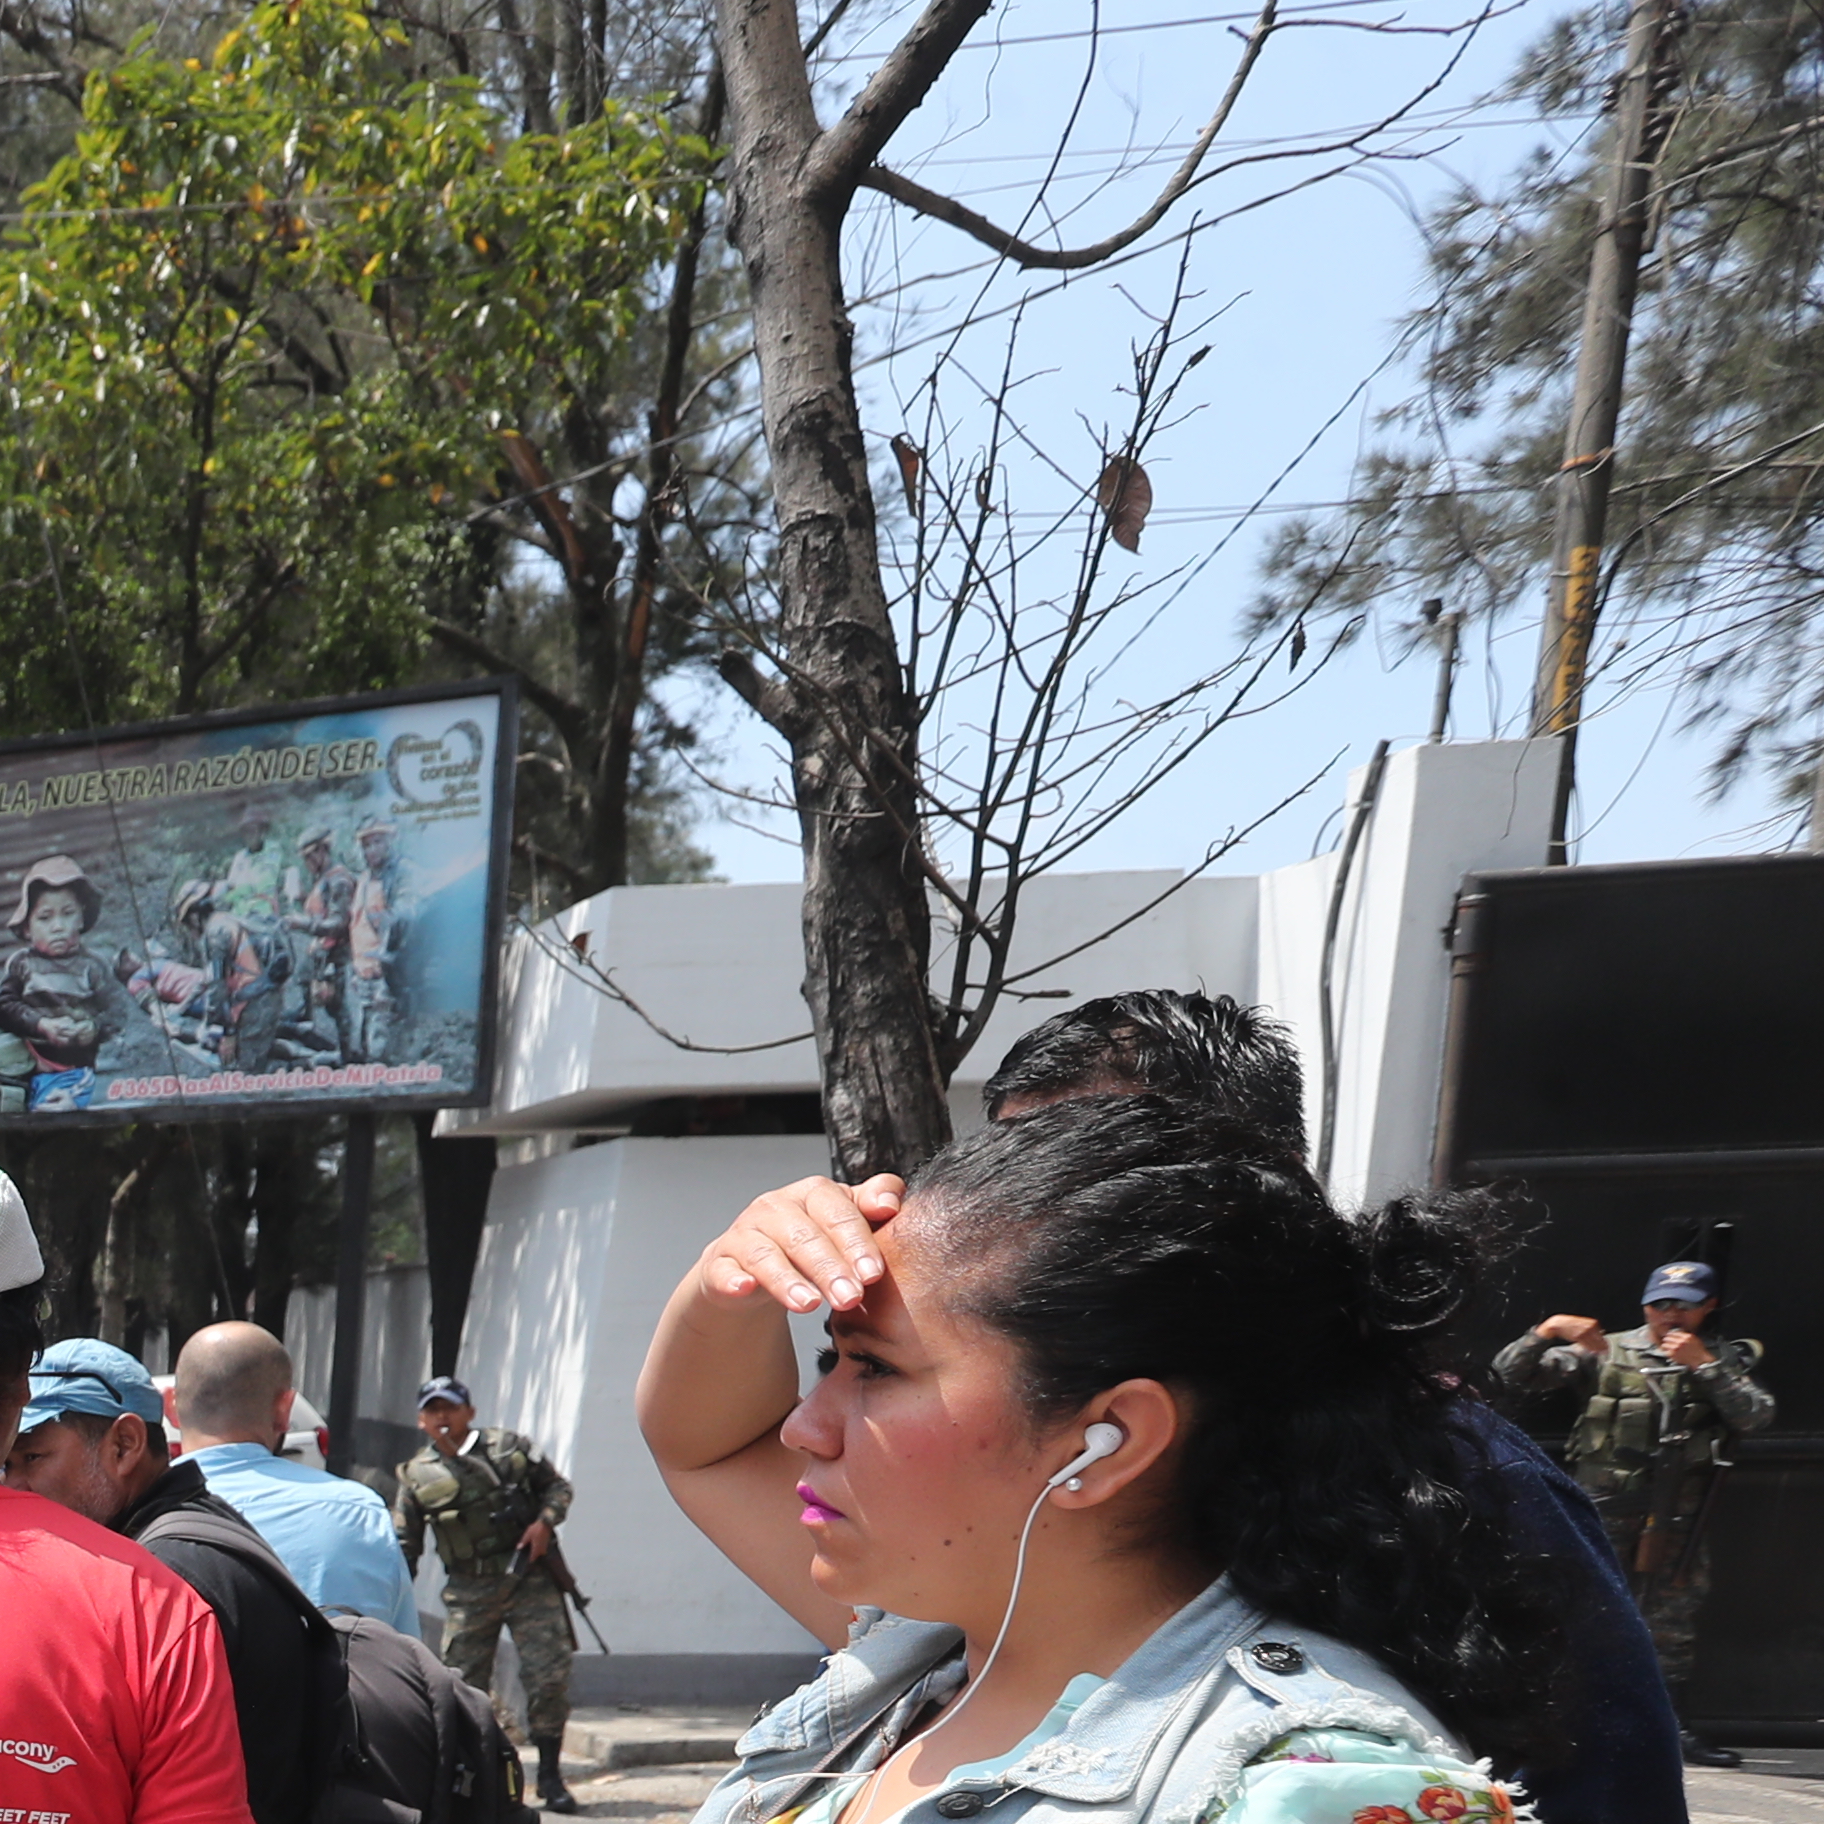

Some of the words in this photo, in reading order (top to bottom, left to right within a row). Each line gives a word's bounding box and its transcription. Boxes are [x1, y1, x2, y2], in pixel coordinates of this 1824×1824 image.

[41, 764, 169, 810] NUESTRA
[172, 746, 276, 795] RAZÓN
[279, 745, 320, 780] DE
[320, 738, 386, 776] SER.
